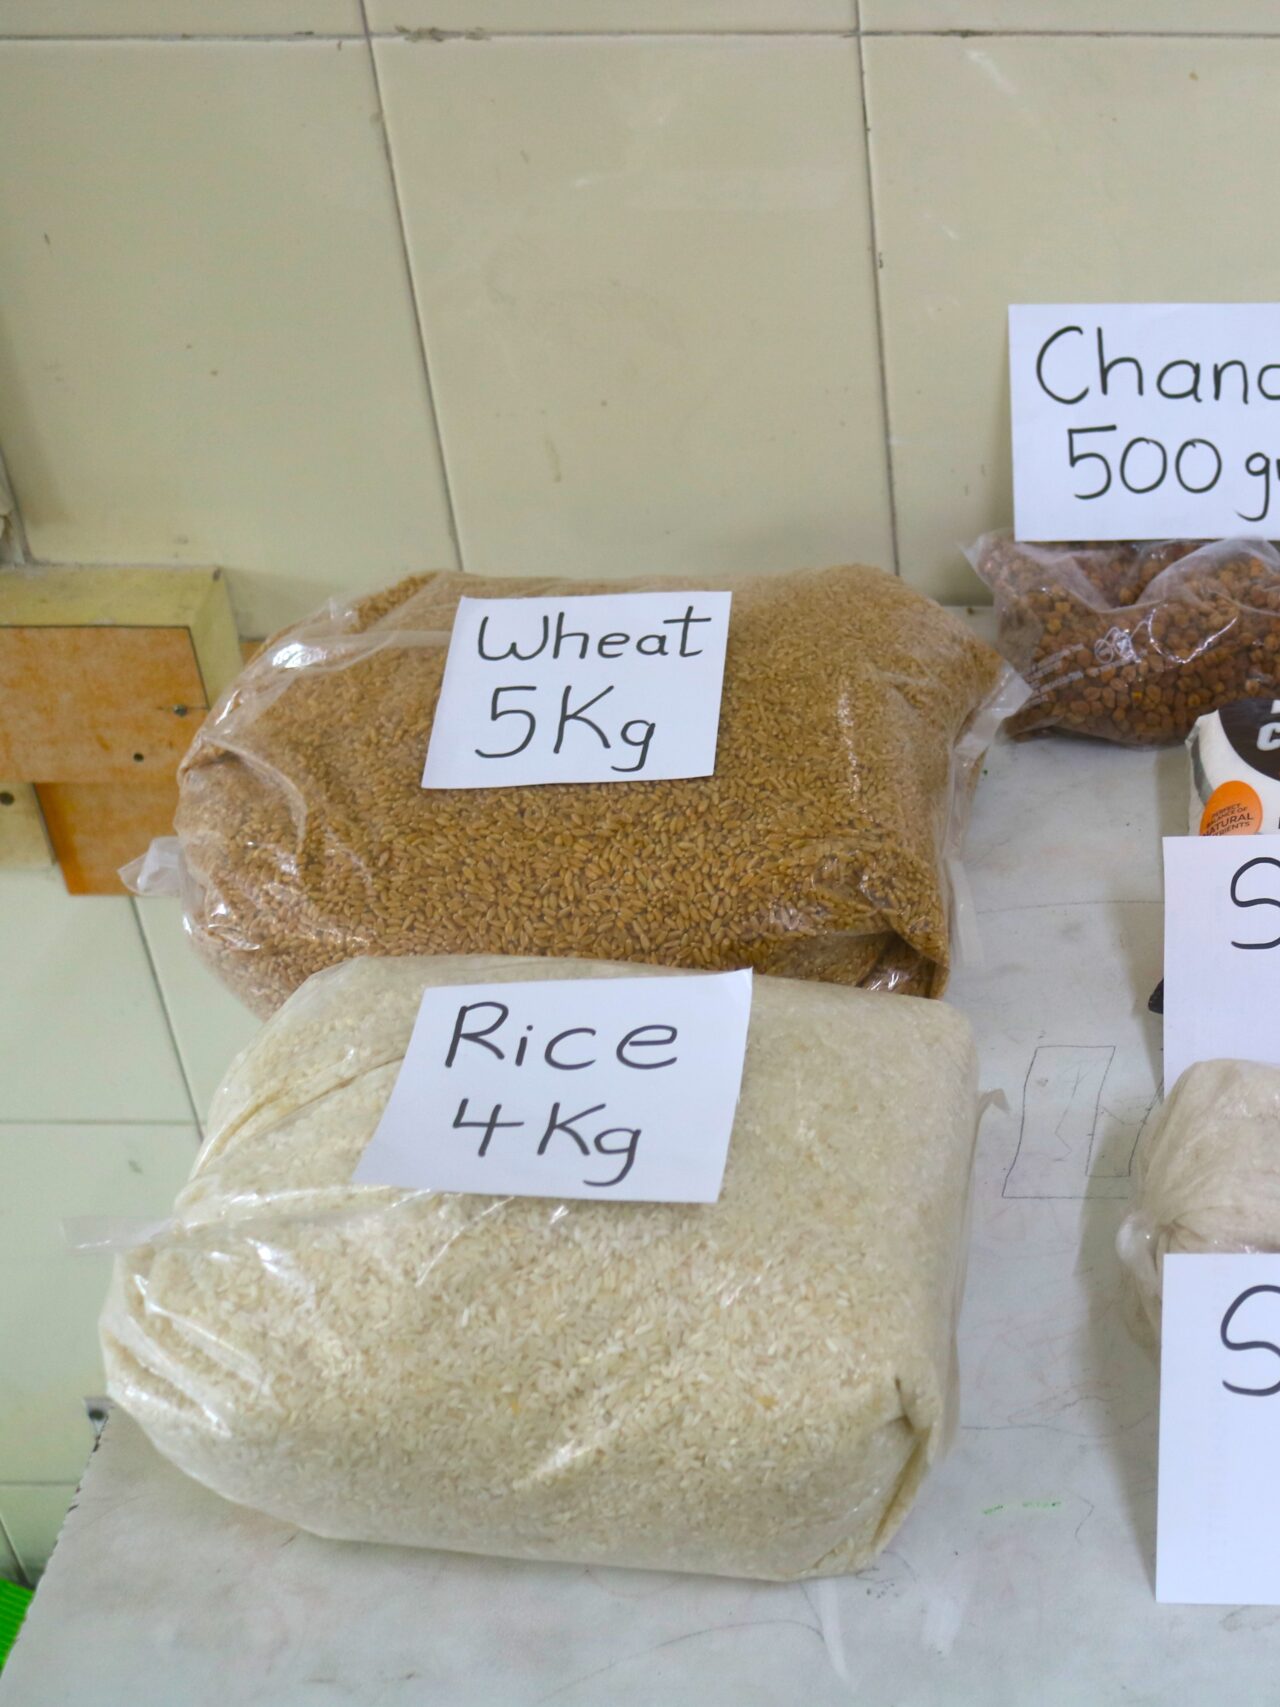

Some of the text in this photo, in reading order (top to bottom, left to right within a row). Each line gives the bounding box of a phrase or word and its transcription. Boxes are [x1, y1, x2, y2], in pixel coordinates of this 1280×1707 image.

[1066, 423, 1223, 501] 500
[477, 604, 713, 662] Wheat
[444, 1000, 679, 1074] Rice
